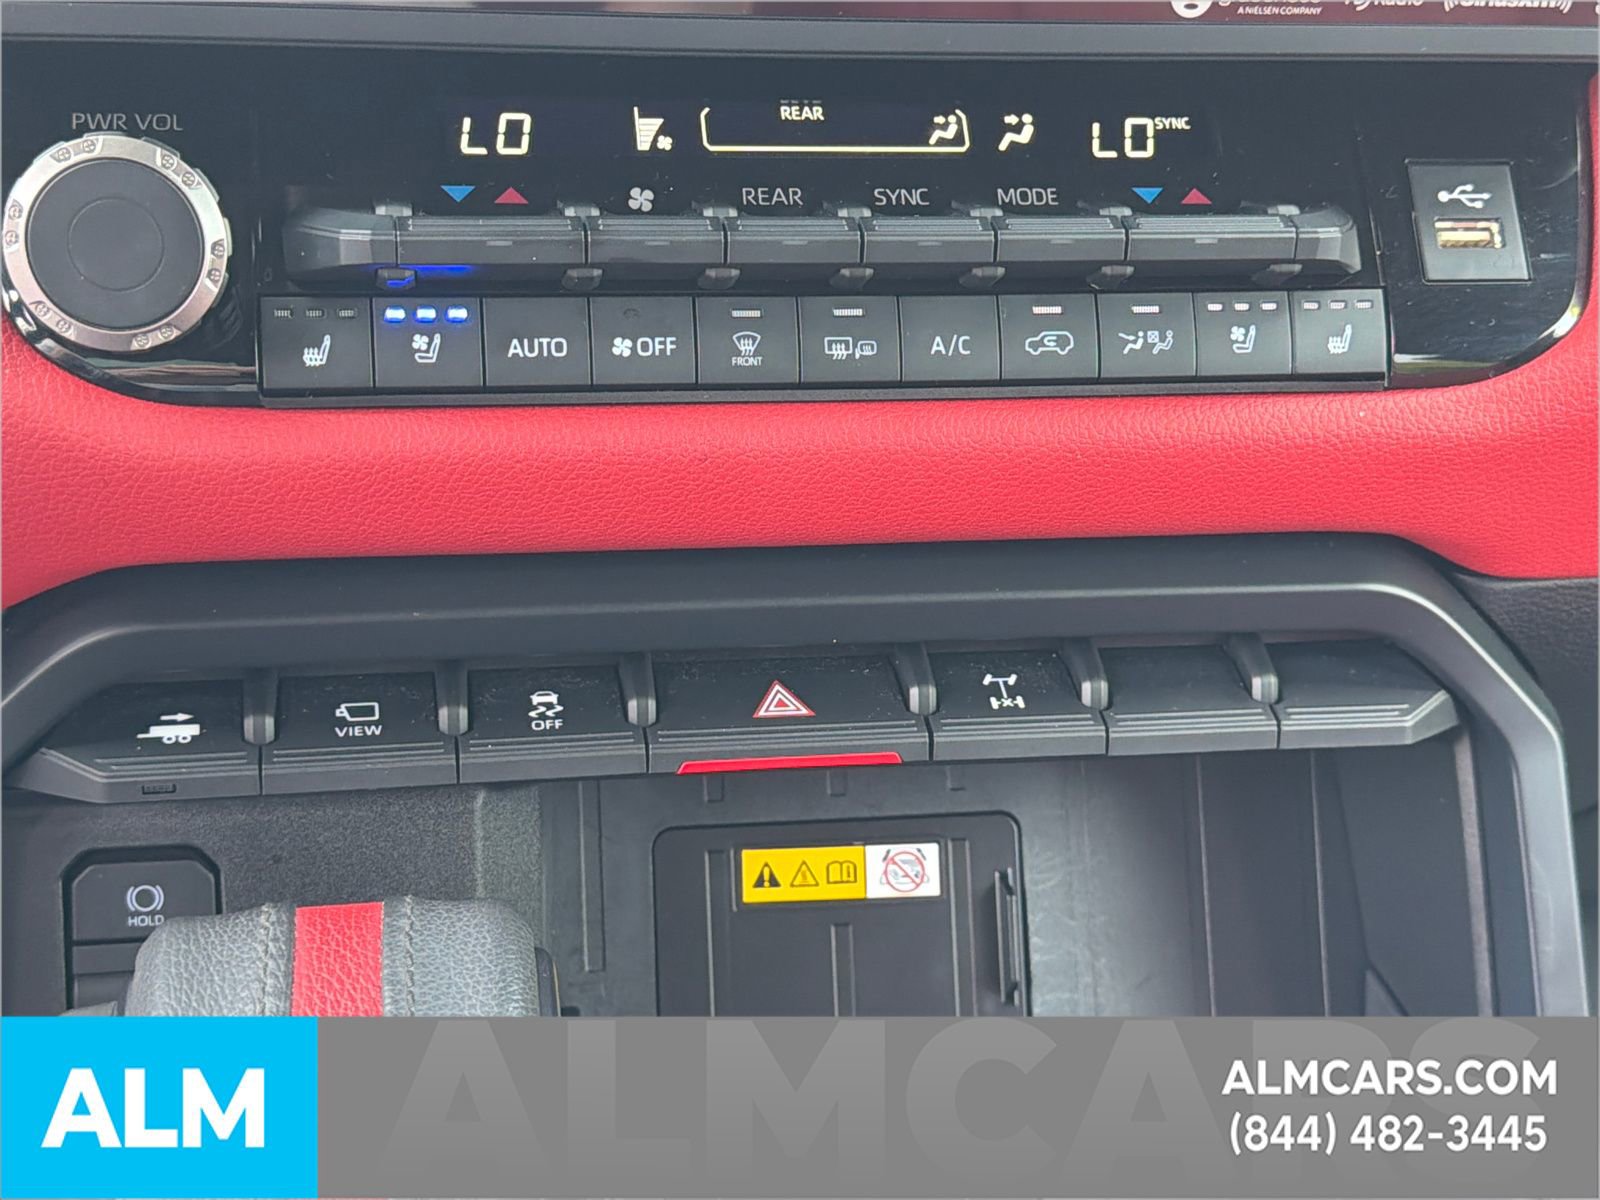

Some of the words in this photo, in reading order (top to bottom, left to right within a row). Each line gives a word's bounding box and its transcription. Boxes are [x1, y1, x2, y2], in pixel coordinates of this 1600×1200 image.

[1236, 6, 1245, 15] A
[1245, 6, 1279, 15] NIELSEN
[1280, 6, 1323, 16] COMPANY
[72, 112, 126, 130] PWR
[134, 113, 183, 131] VOL
[780, 105, 825, 121] REAR
[1154, 116, 1191, 130] SYNC
[460, 112, 532, 156] LO
[1092, 117, 1154, 159] LO
[742, 187, 804, 206] REAR
[873, 188, 930, 206] SYNC
[996, 187, 1059, 206] MODE
[507, 337, 568, 358] AUTO
[636, 336, 677, 357] OFF
[930, 334, 971, 357] A/C
[731, 355, 763, 367] FRONT
[335, 723, 383, 738] VIEW
[531, 716, 564, 731] OFF
[127, 914, 165, 927] HOLD
